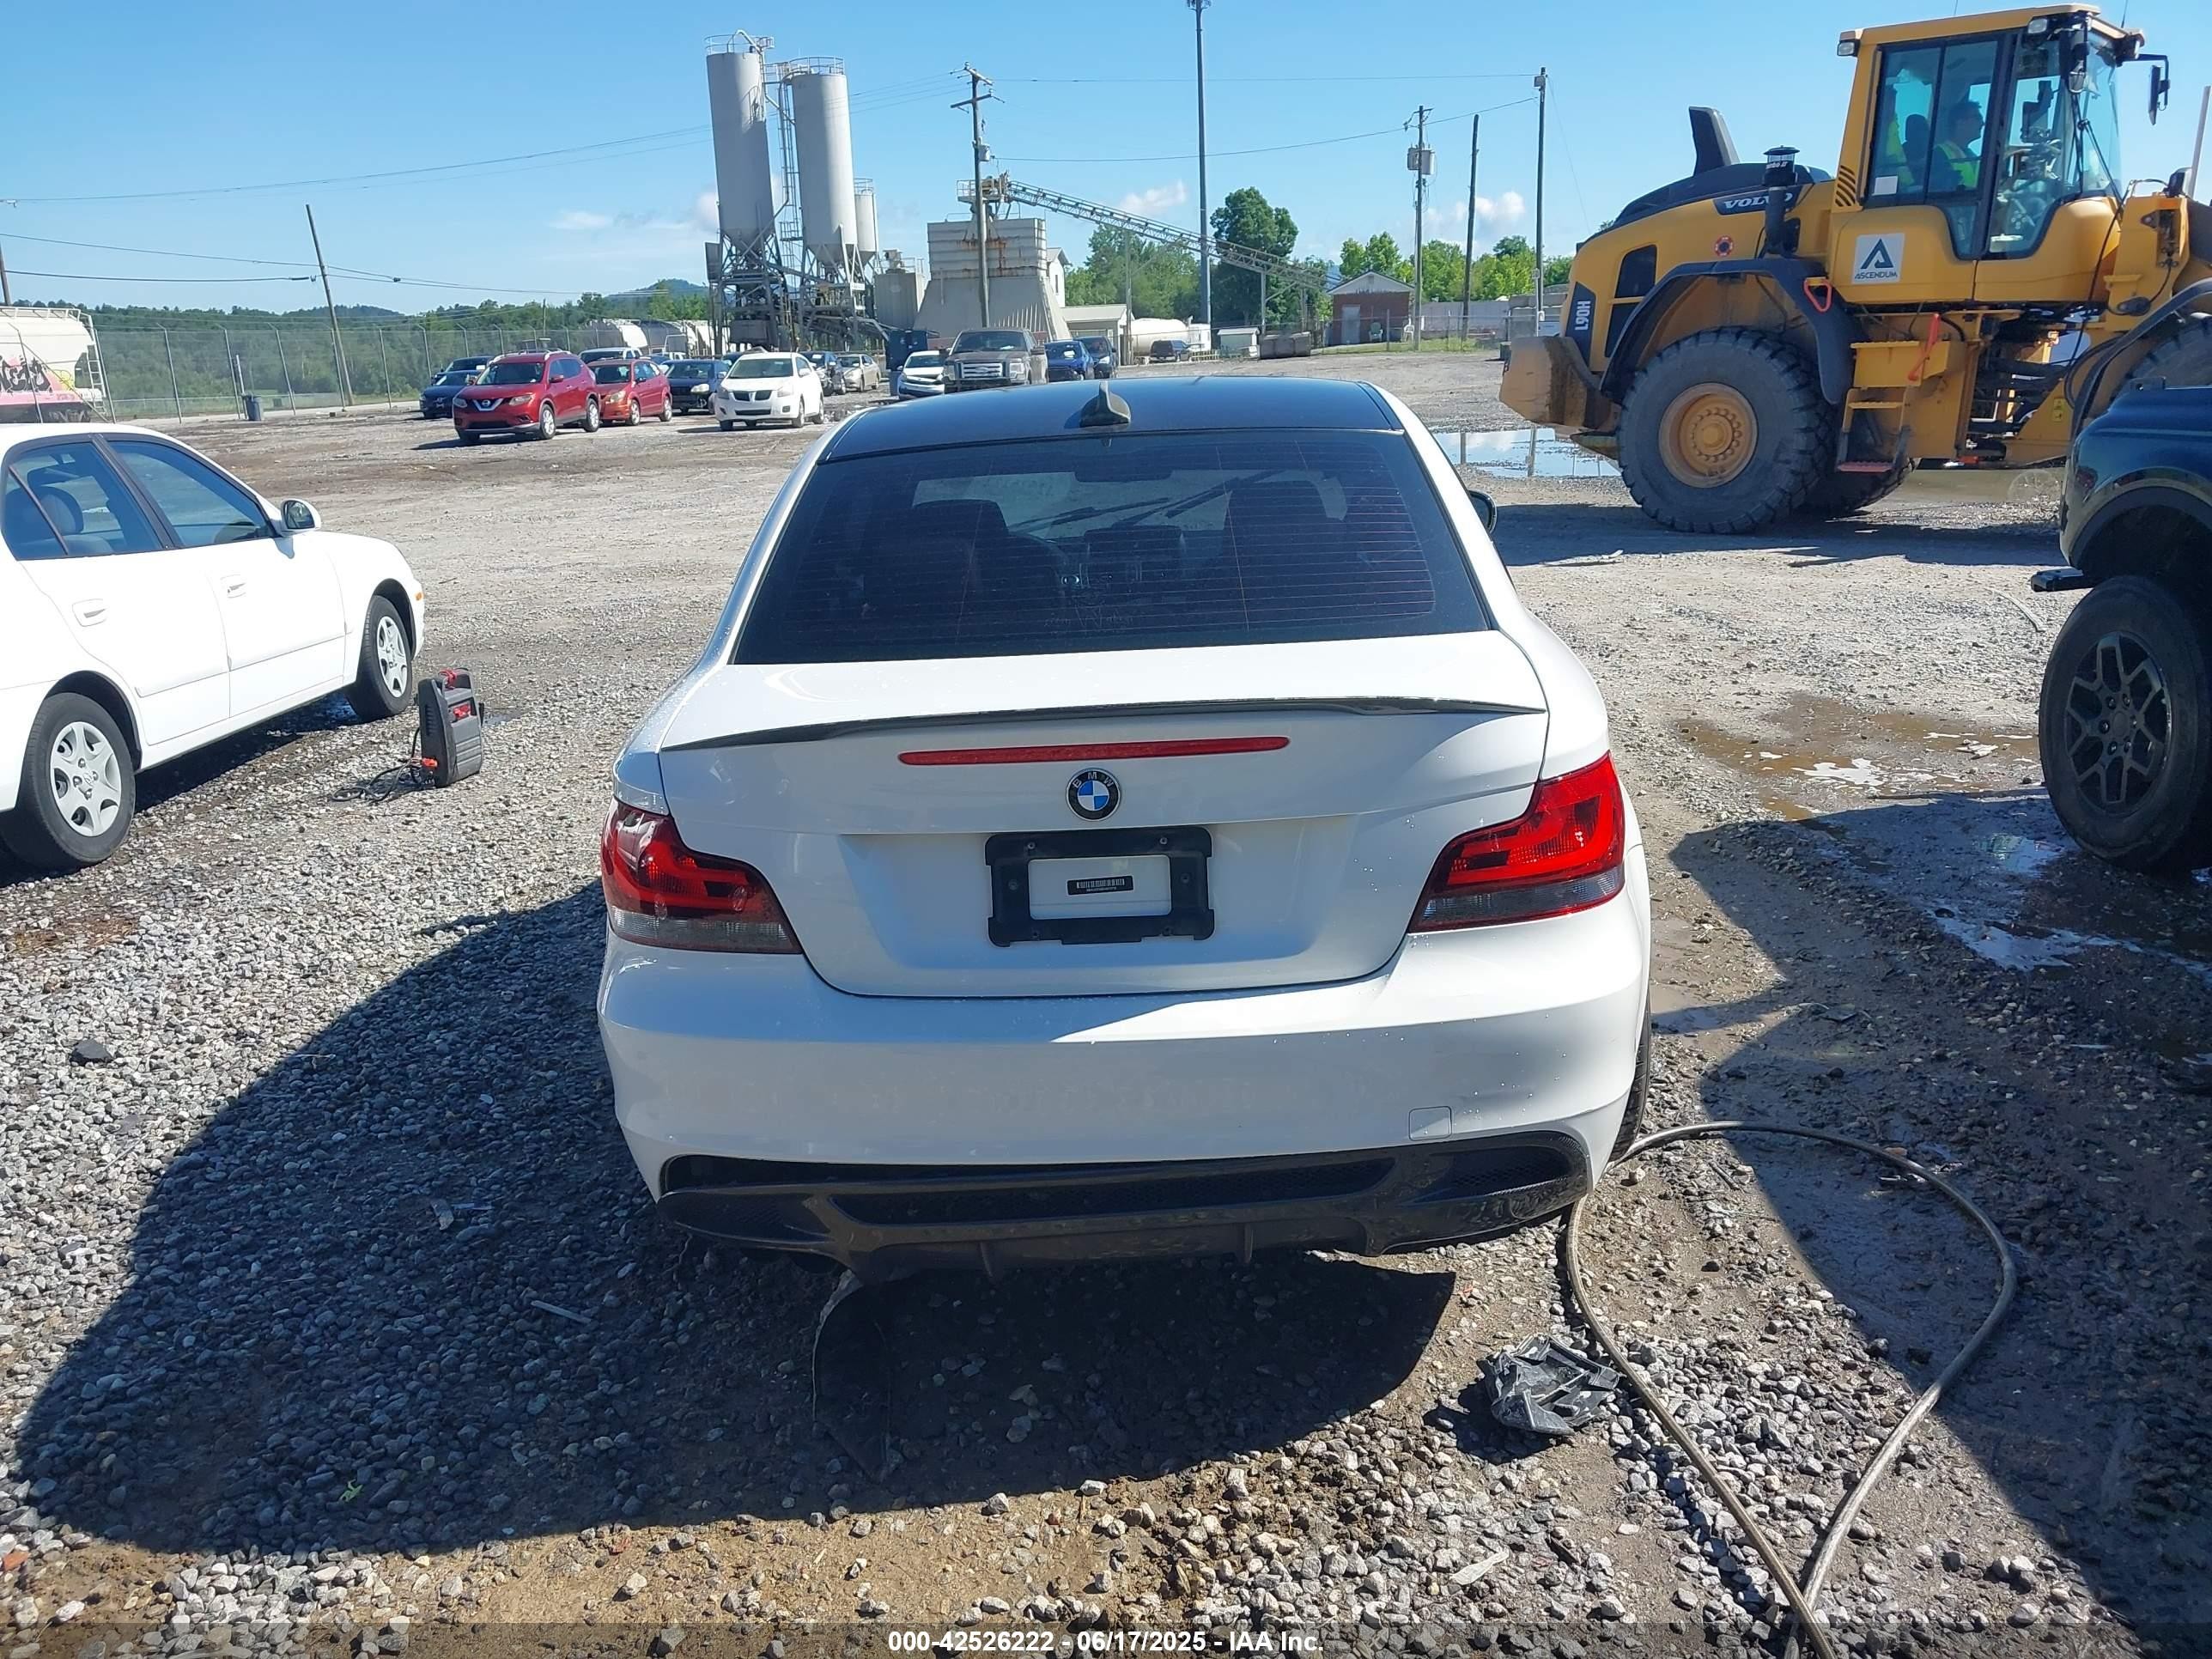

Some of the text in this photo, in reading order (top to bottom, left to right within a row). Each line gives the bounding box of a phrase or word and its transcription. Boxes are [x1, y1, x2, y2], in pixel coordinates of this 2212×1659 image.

[1855, 271, 1898, 280] ASCENDUM
[1574, 301, 1591, 331] L90H
[1073, 771, 1114, 788] BMW
